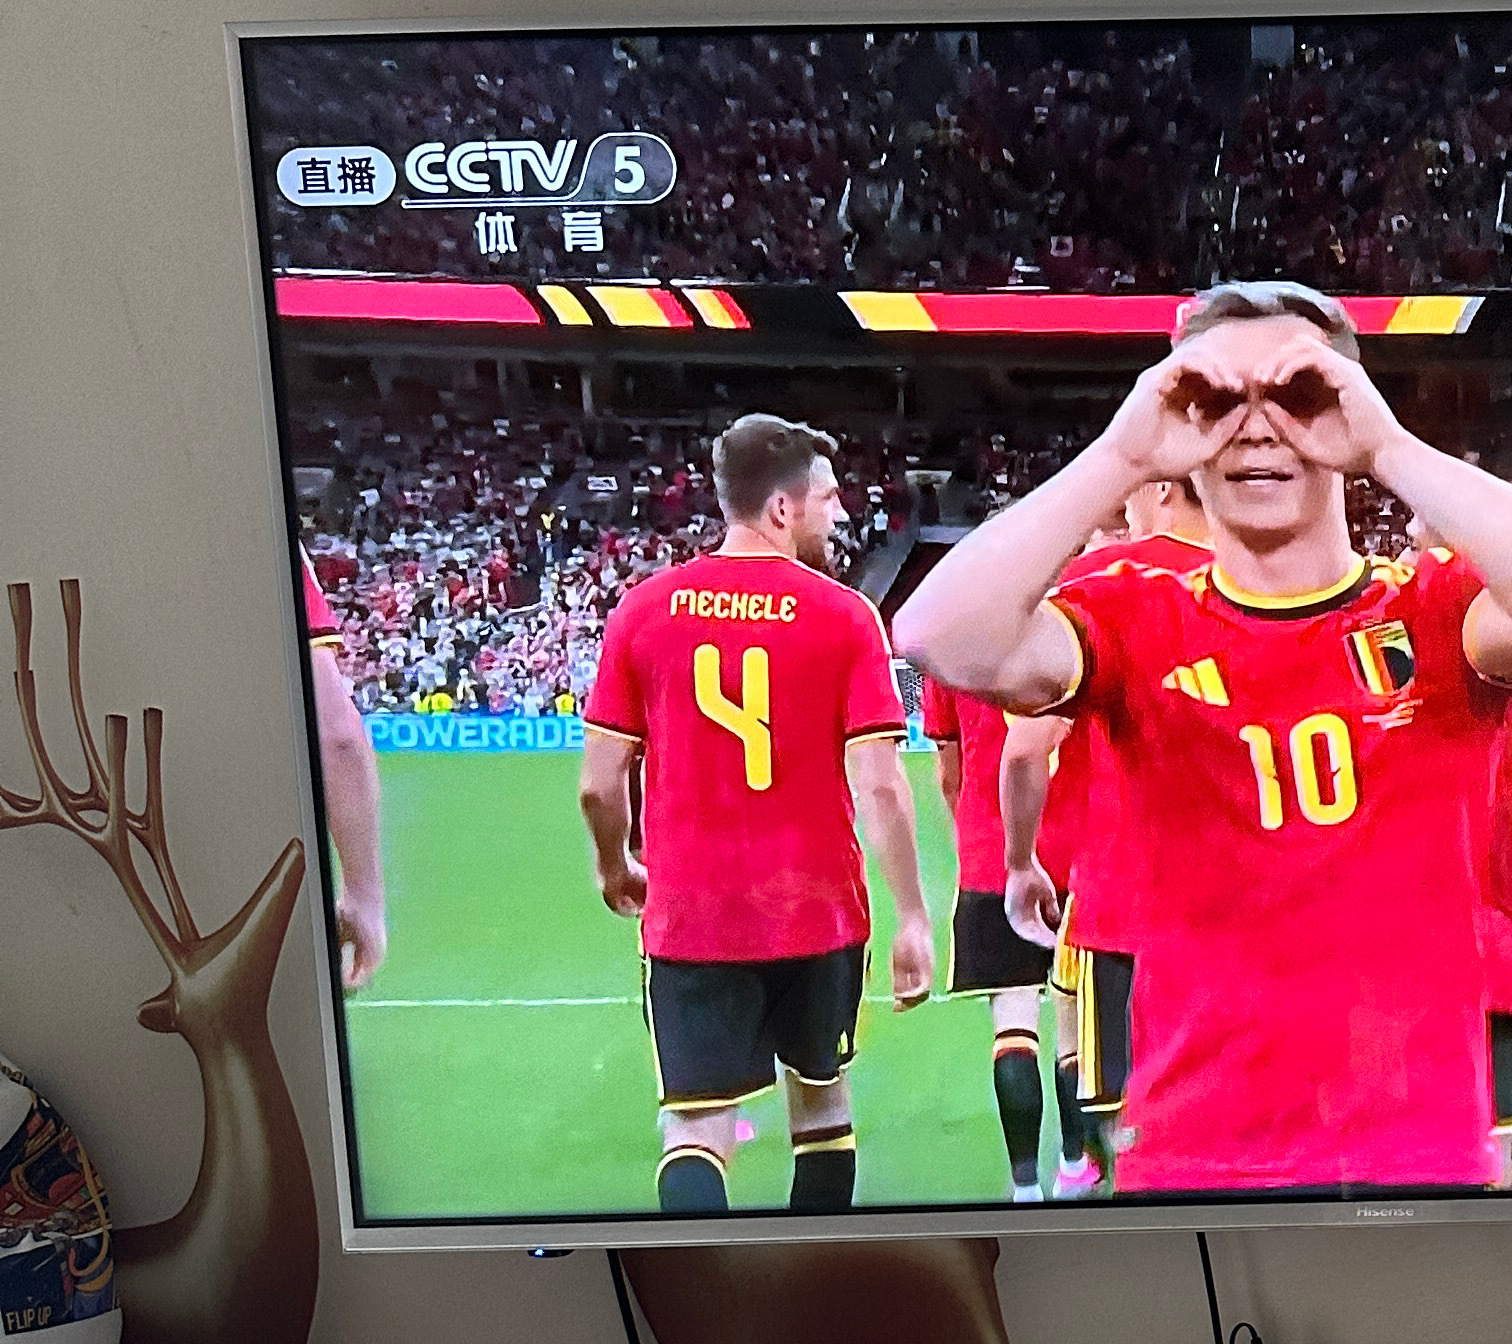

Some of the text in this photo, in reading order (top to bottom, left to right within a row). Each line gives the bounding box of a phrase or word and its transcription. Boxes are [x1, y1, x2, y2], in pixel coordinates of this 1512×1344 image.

[297, 157, 376, 194] 直播
[405, 139, 647, 194] CCTV 5
[671, 587, 798, 623] MECHELE
[368, 717, 584, 748] POWERADE
[693, 643, 772, 792] 4
[1239, 712, 1359, 831] 10
[1356, 1206, 1415, 1217] Hisense
[6, 1306, 51, 1331] FLIP UP
